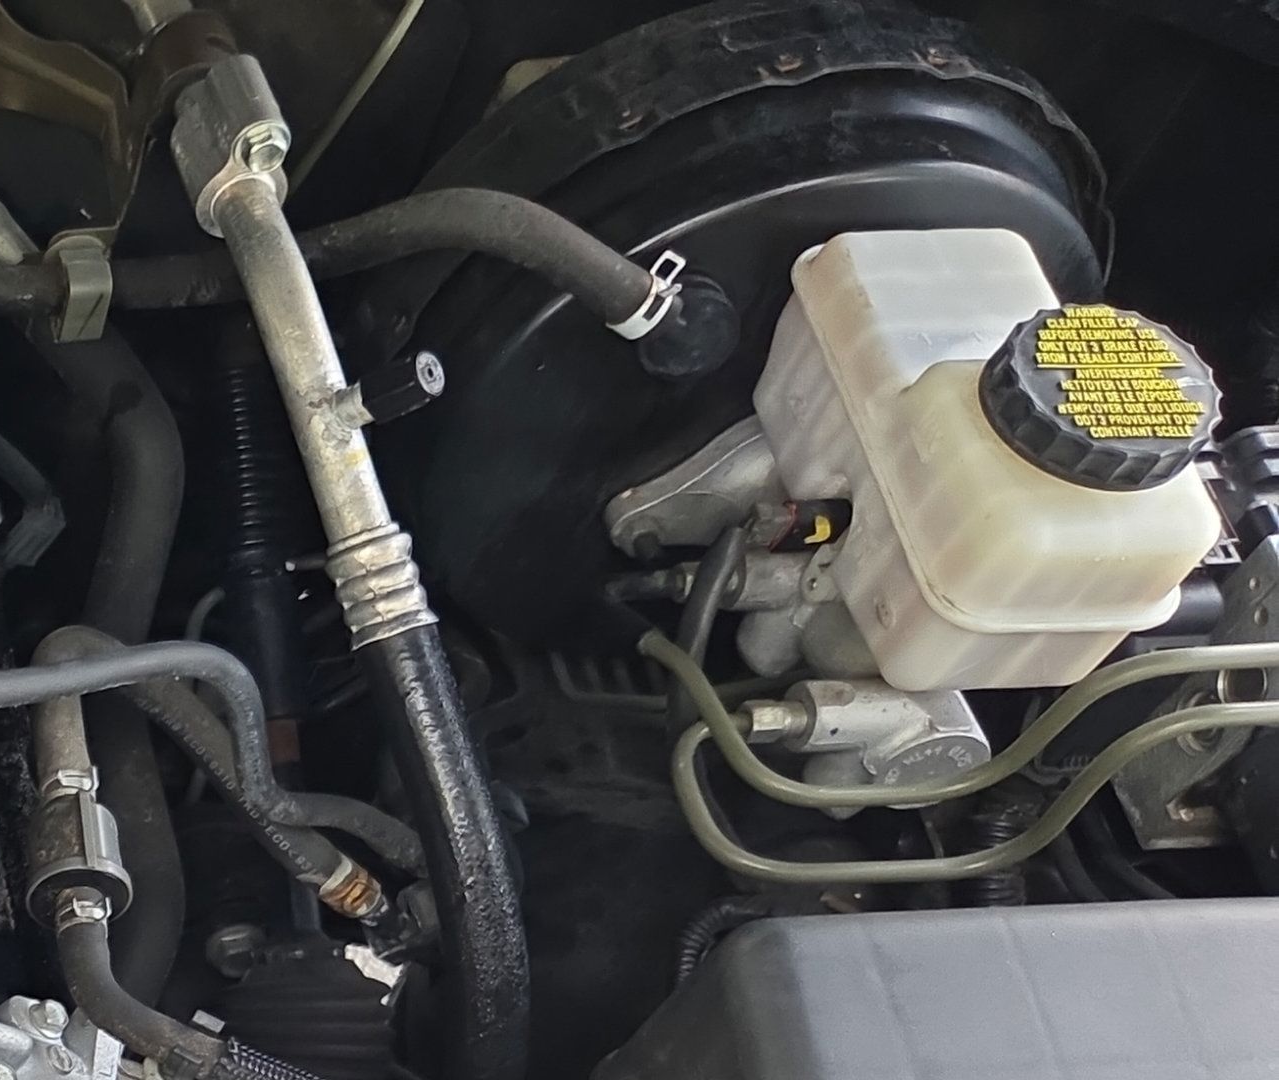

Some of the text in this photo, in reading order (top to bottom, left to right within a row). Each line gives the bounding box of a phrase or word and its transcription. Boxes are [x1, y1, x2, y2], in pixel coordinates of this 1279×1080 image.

[1081, 318, 1117, 328] FILLER
[1038, 329, 1079, 340] BEFORE
[1137, 329, 1160, 339] USE
[1038, 340, 1170, 352] ONLY DOT 3 BRAKE FLUID
[1035, 352, 1068, 363] FROM
[1069, 352, 1078, 363] A
[1078, 352, 1118, 363] SEALED
[1060, 380, 1116, 391] NETTOYER
[1116, 380, 1132, 390] LE
[1068, 391, 1104, 402] AVANT
[1105, 391, 1122, 402] DE
[1122, 391, 1136, 402] LE
[1124, 403, 1147, 414] QUE
[1148, 403, 1163, 413] DU
[1074, 415, 1099, 426] DOT
[1099, 415, 1108, 426] 3
[1108, 414, 1169, 426] PROVENANT
[1089, 426, 1153, 438] CONTENANT
